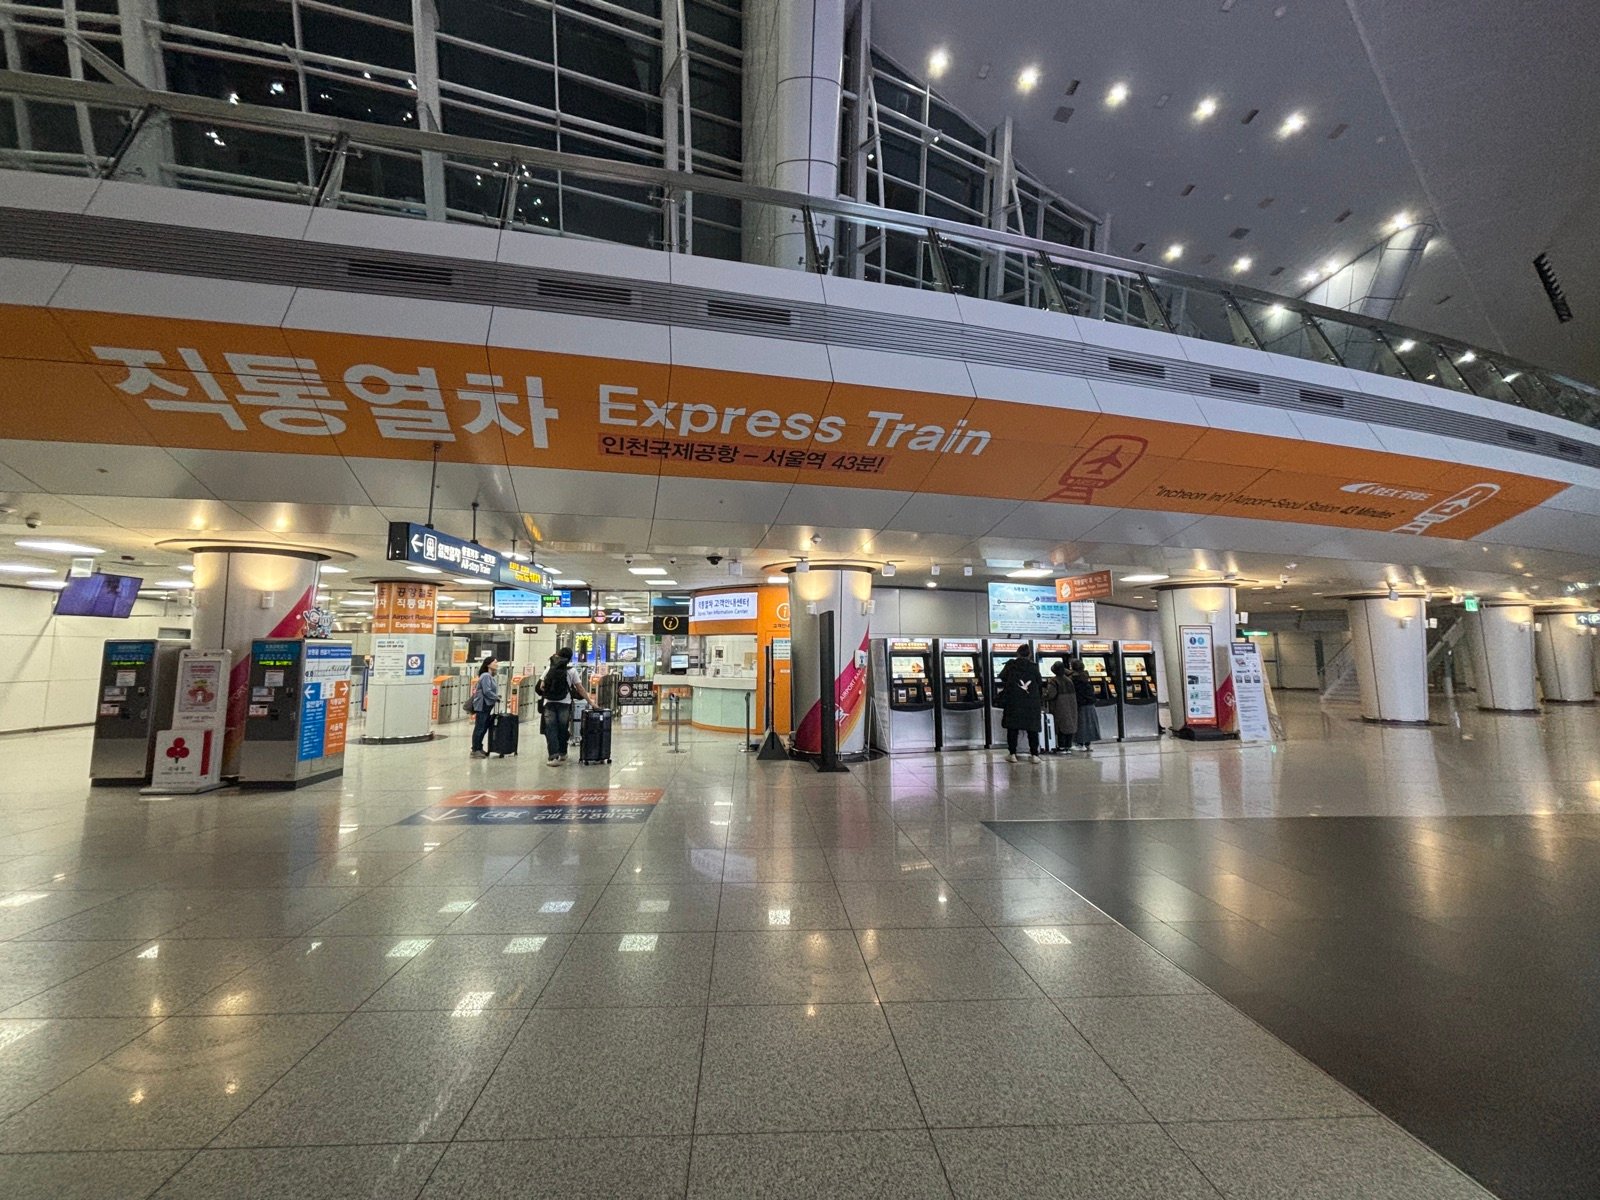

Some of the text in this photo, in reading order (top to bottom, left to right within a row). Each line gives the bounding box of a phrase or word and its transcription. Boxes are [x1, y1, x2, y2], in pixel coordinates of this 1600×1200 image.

[91, 346, 559, 449] 직통열차
[598, 384, 993, 456] Express Train
[601, 435, 740, 463] 인천국제공항
[762, 447, 828, 470] 서울역
[831, 452, 884, 473] 43분!
[396, 598, 433, 610] 직통열차
[397, 587, 433, 598] 공항철도
[714, 597, 750, 608] 고객안내센터
